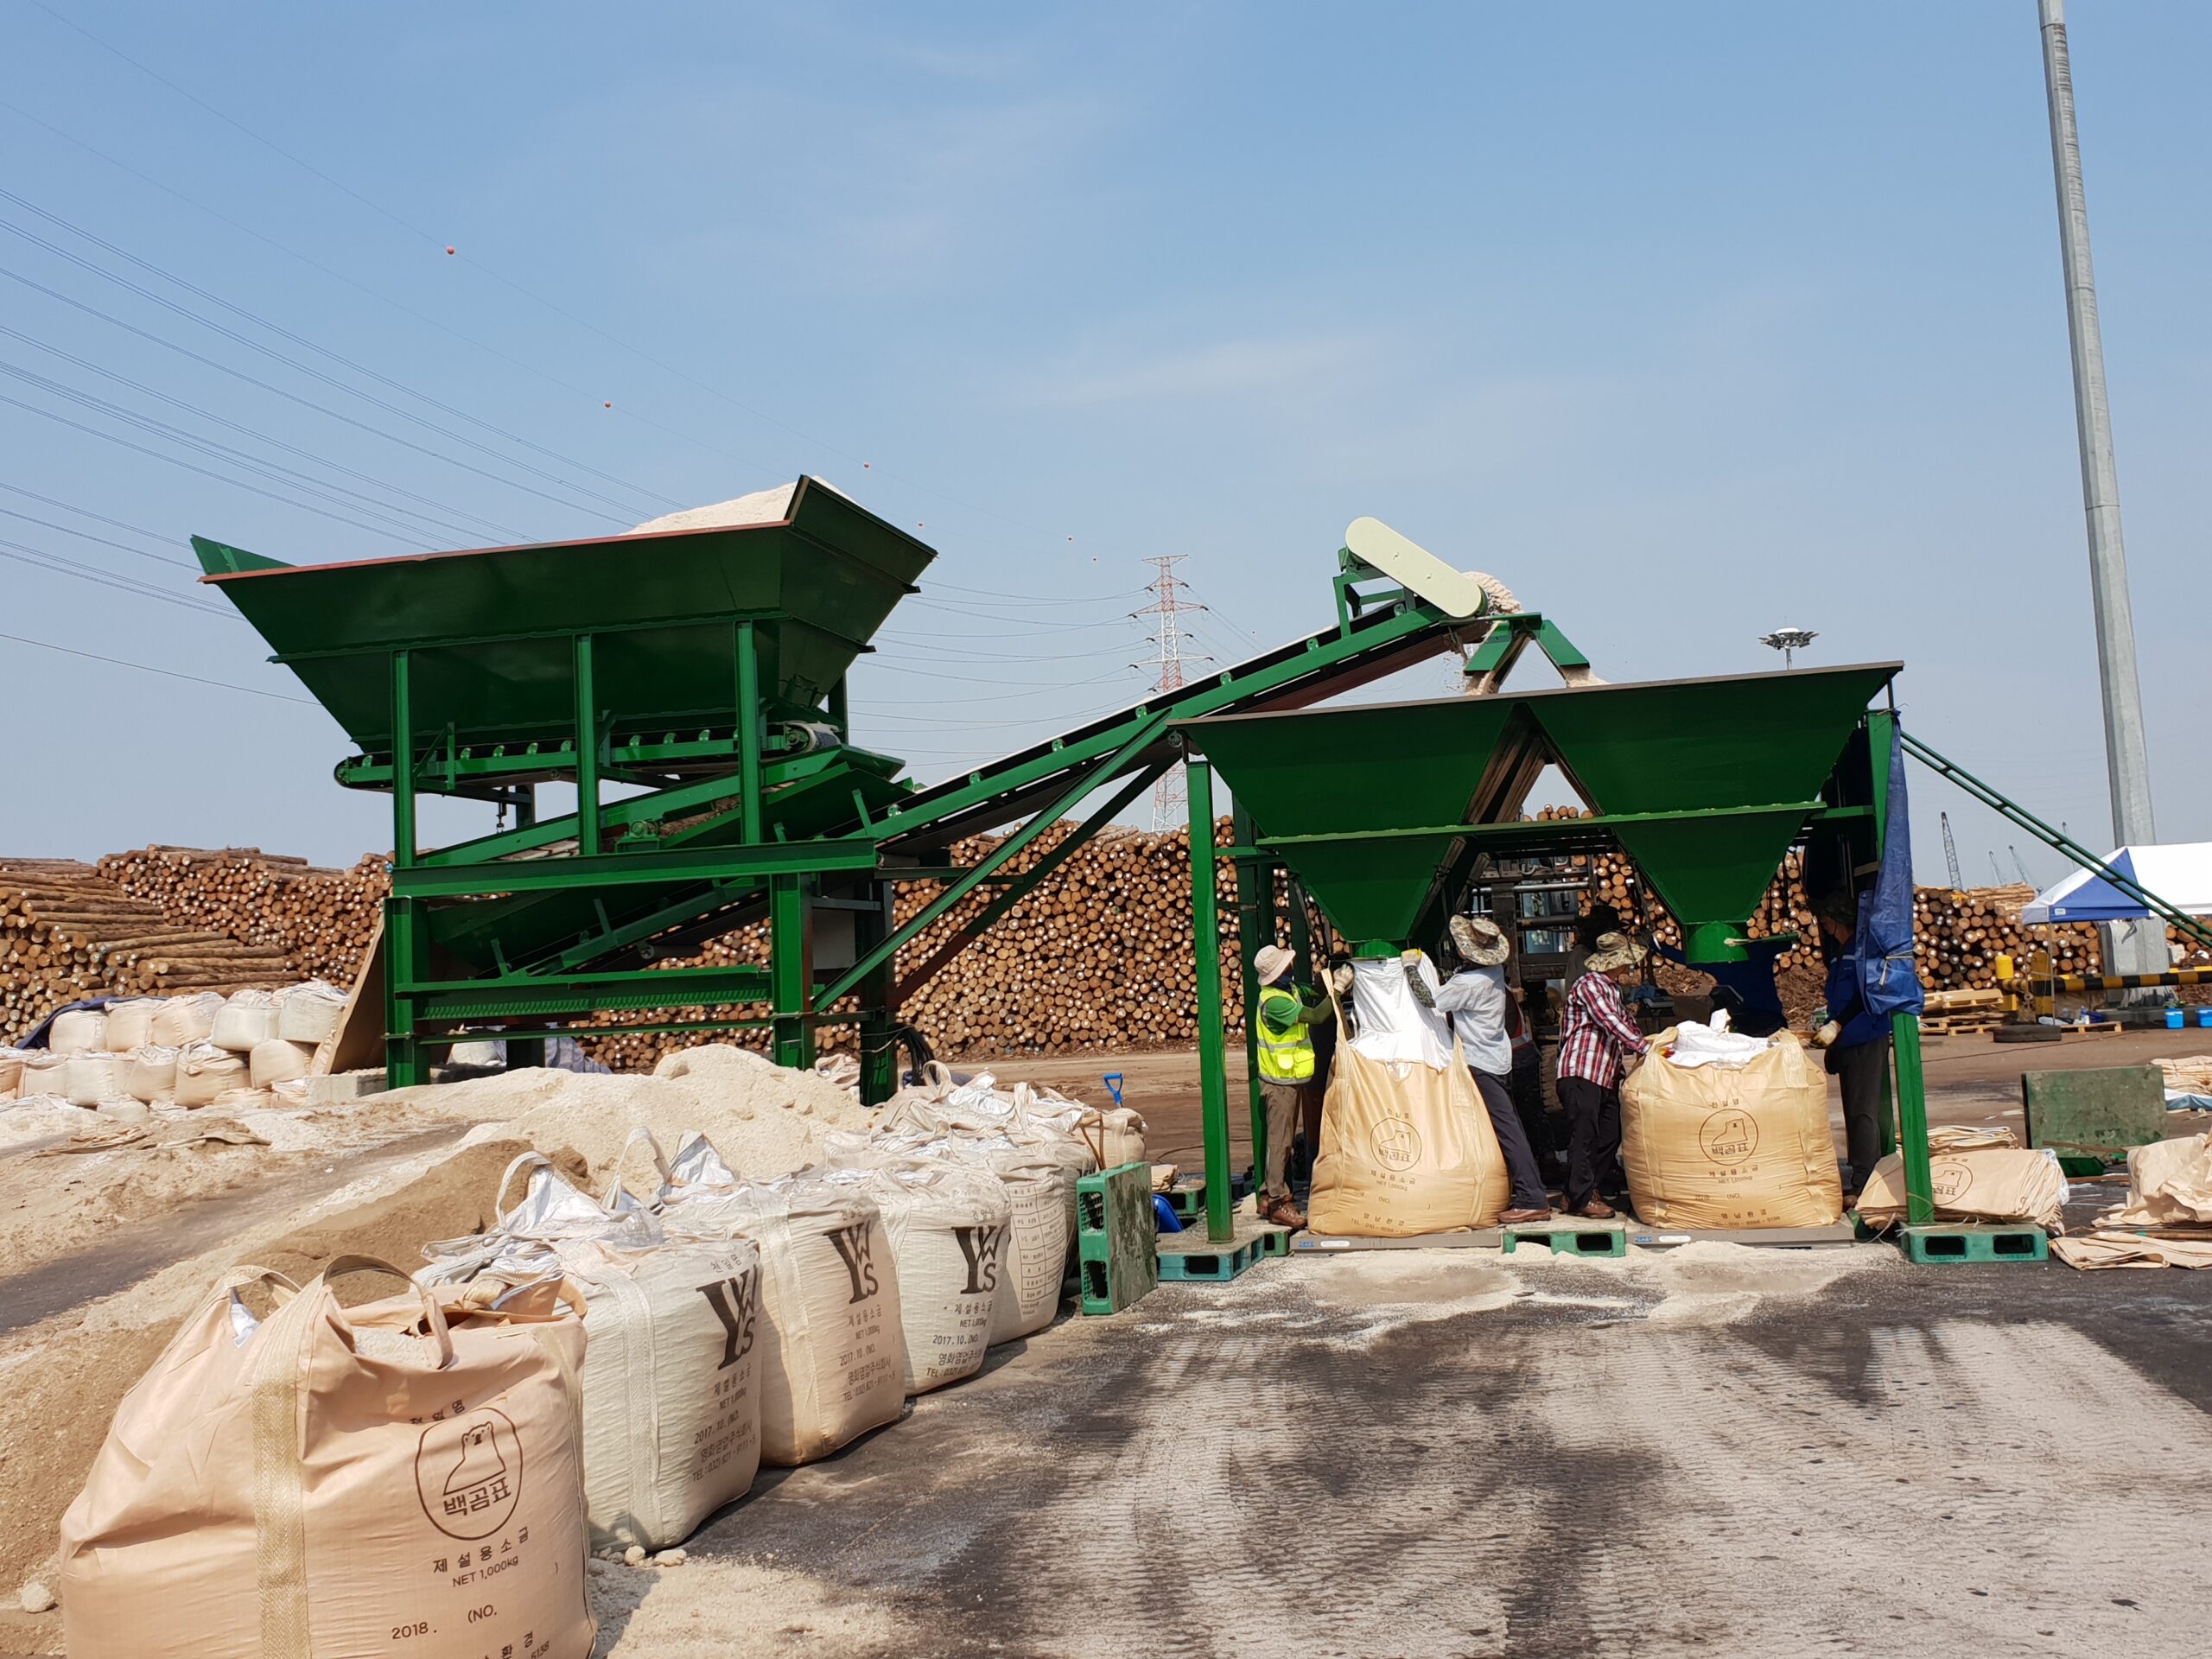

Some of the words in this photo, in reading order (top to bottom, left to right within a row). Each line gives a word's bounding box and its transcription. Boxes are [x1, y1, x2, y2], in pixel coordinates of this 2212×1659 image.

[1378, 1147, 1411, 1163] 백곰표
[1712, 1142, 1749, 1155] 백곰표
[1932, 1185, 1956, 1196] 곰표
[442, 1476, 512, 1516] 백곰표
[433, 1526, 530, 1573] 제설용소금
[452, 1571, 477, 1588] NET
[479, 1555, 519, 1580] 1,000kg
[467, 1604, 498, 1624] (NO.
